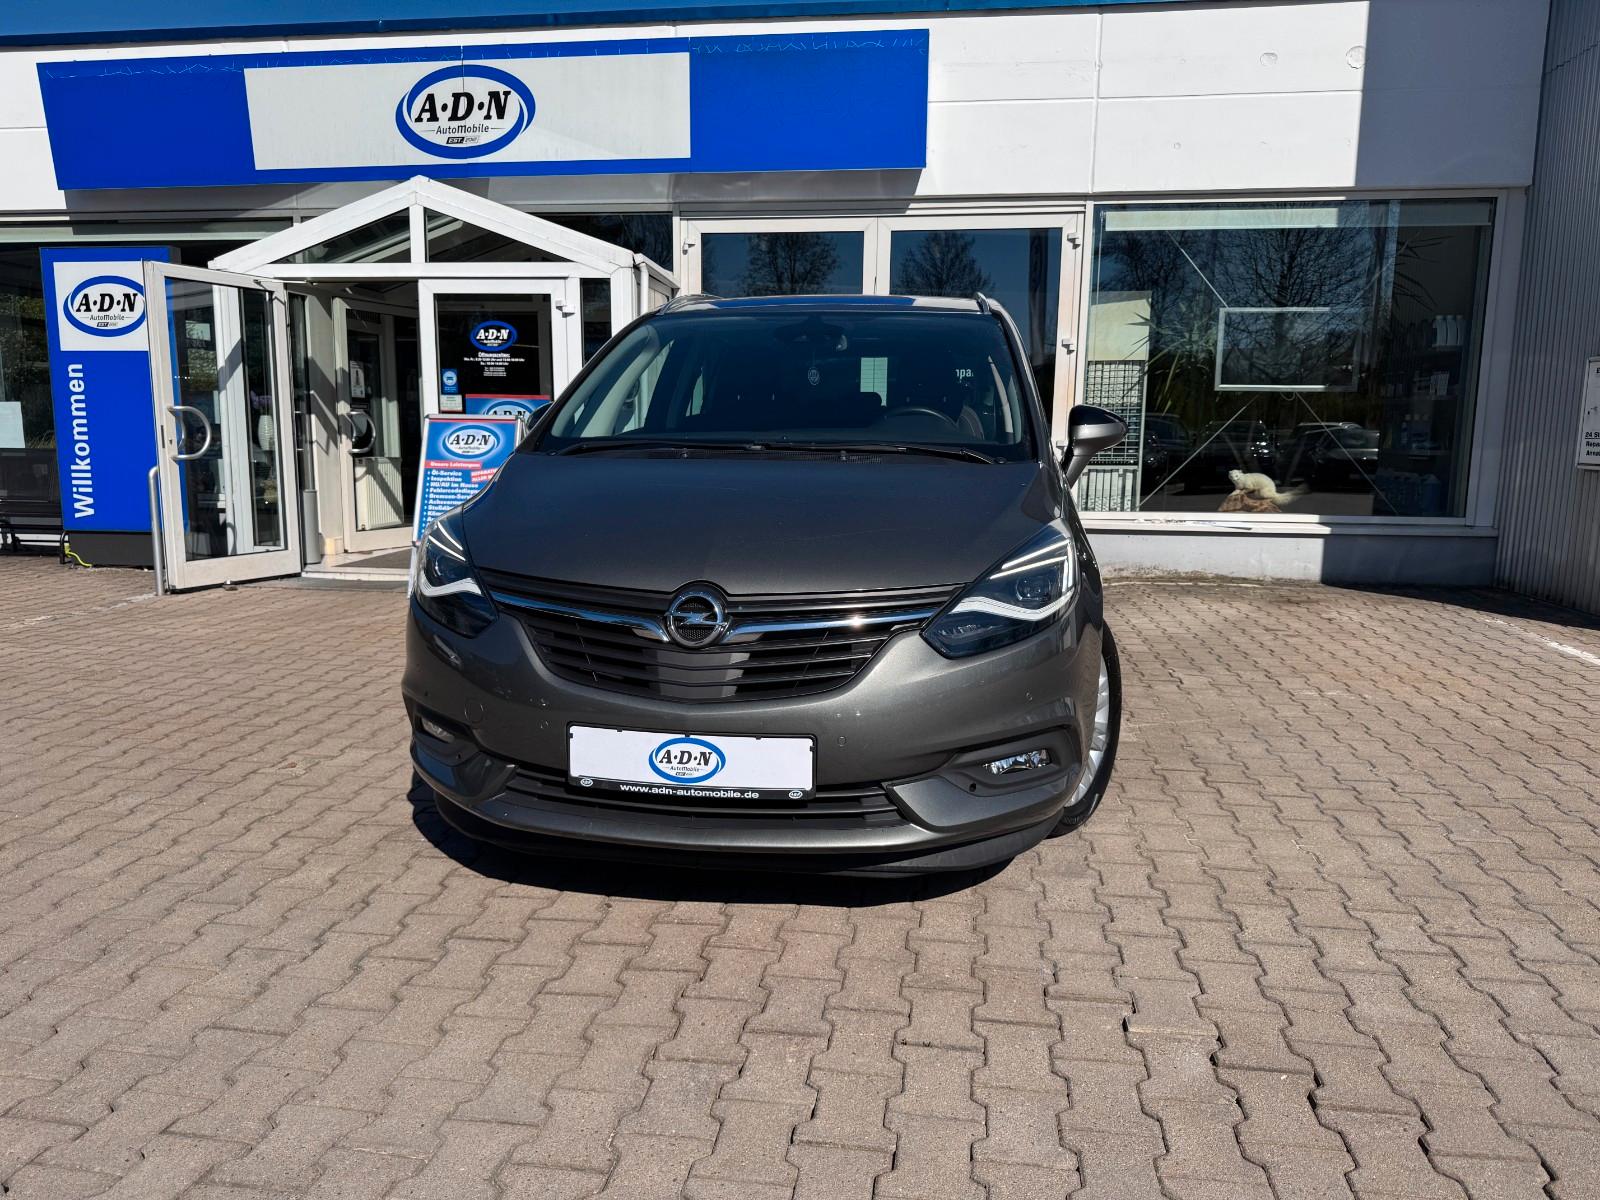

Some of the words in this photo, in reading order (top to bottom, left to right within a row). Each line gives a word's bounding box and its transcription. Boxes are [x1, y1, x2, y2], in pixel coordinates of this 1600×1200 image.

[435, 124, 490, 135] AutoMobile
[67, 363, 95, 519] Willkommen
[619, 783, 760, 799] www.adn-automobile.de
